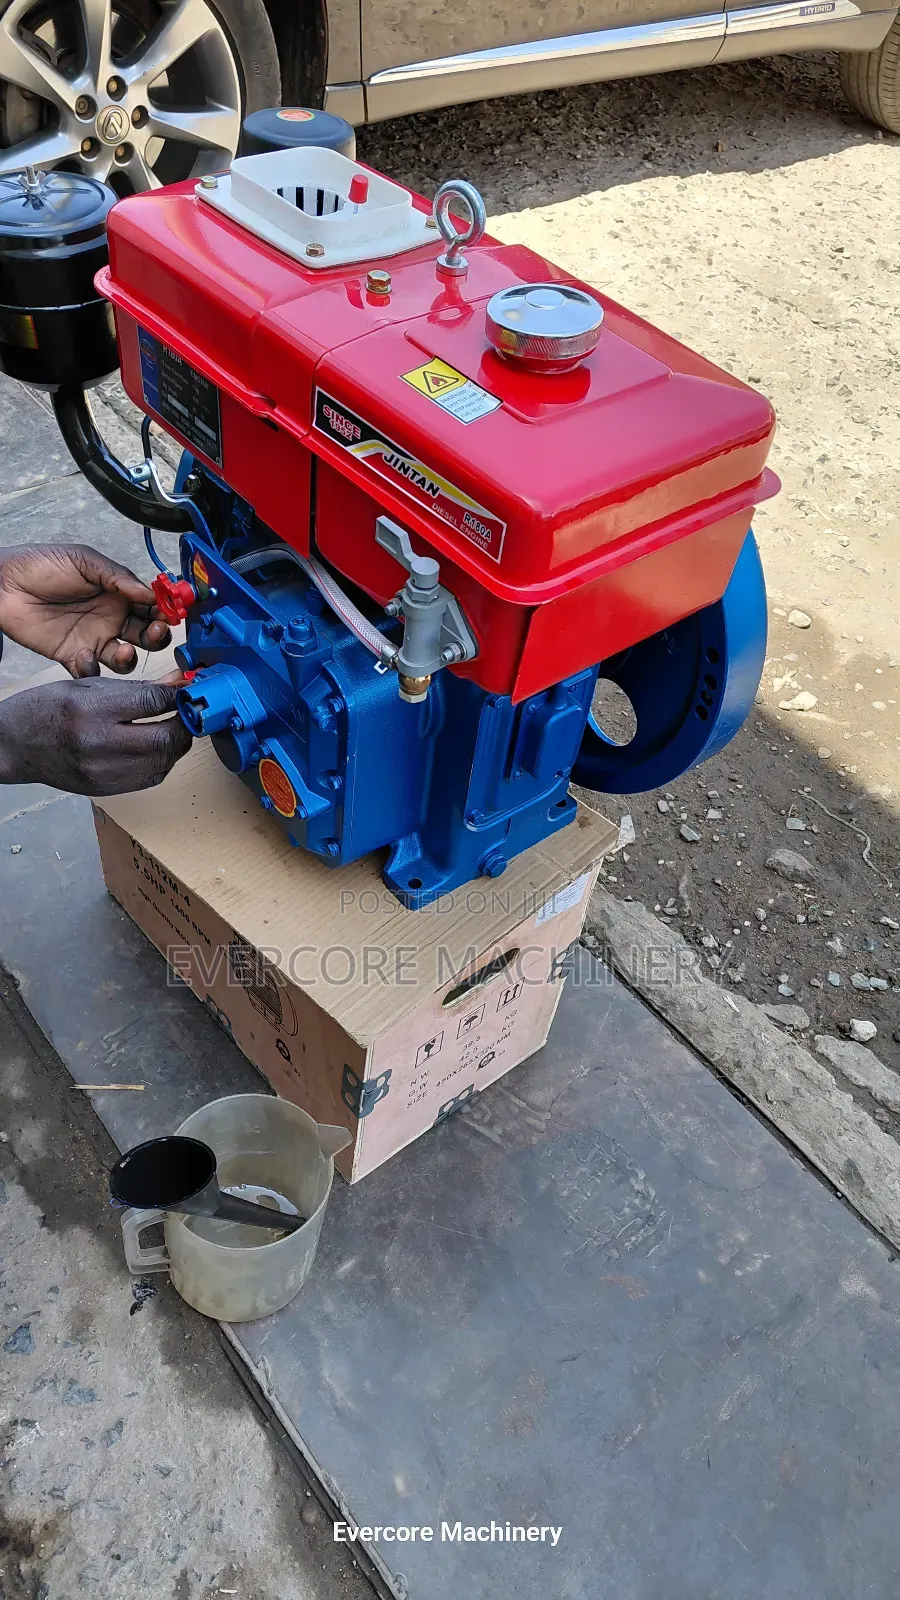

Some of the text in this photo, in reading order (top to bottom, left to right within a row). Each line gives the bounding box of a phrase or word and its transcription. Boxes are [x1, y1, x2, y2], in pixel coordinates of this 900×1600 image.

[804, 4, 832, 15] HYBRID
[323, 405, 361, 439] SINCE
[329, 420, 353, 441] 1952
[382, 452, 441, 498] JINTAN
[432, 502, 489, 550] DIESEL ENGINE
[463, 511, 492, 542] R180A
[129, 835, 190, 906] Y3-112M-4
[133, 856, 212, 947] 5.5HP 1400 RPM
[137, 885, 151, 904] High
[152, 902, 174, 929] Quality
[504, 1009, 518, 1022] KG
[458, 1045, 479, 1063] 42.5
[501, 1020, 515, 1033] KG
[495, 1031, 511, 1046] MM
